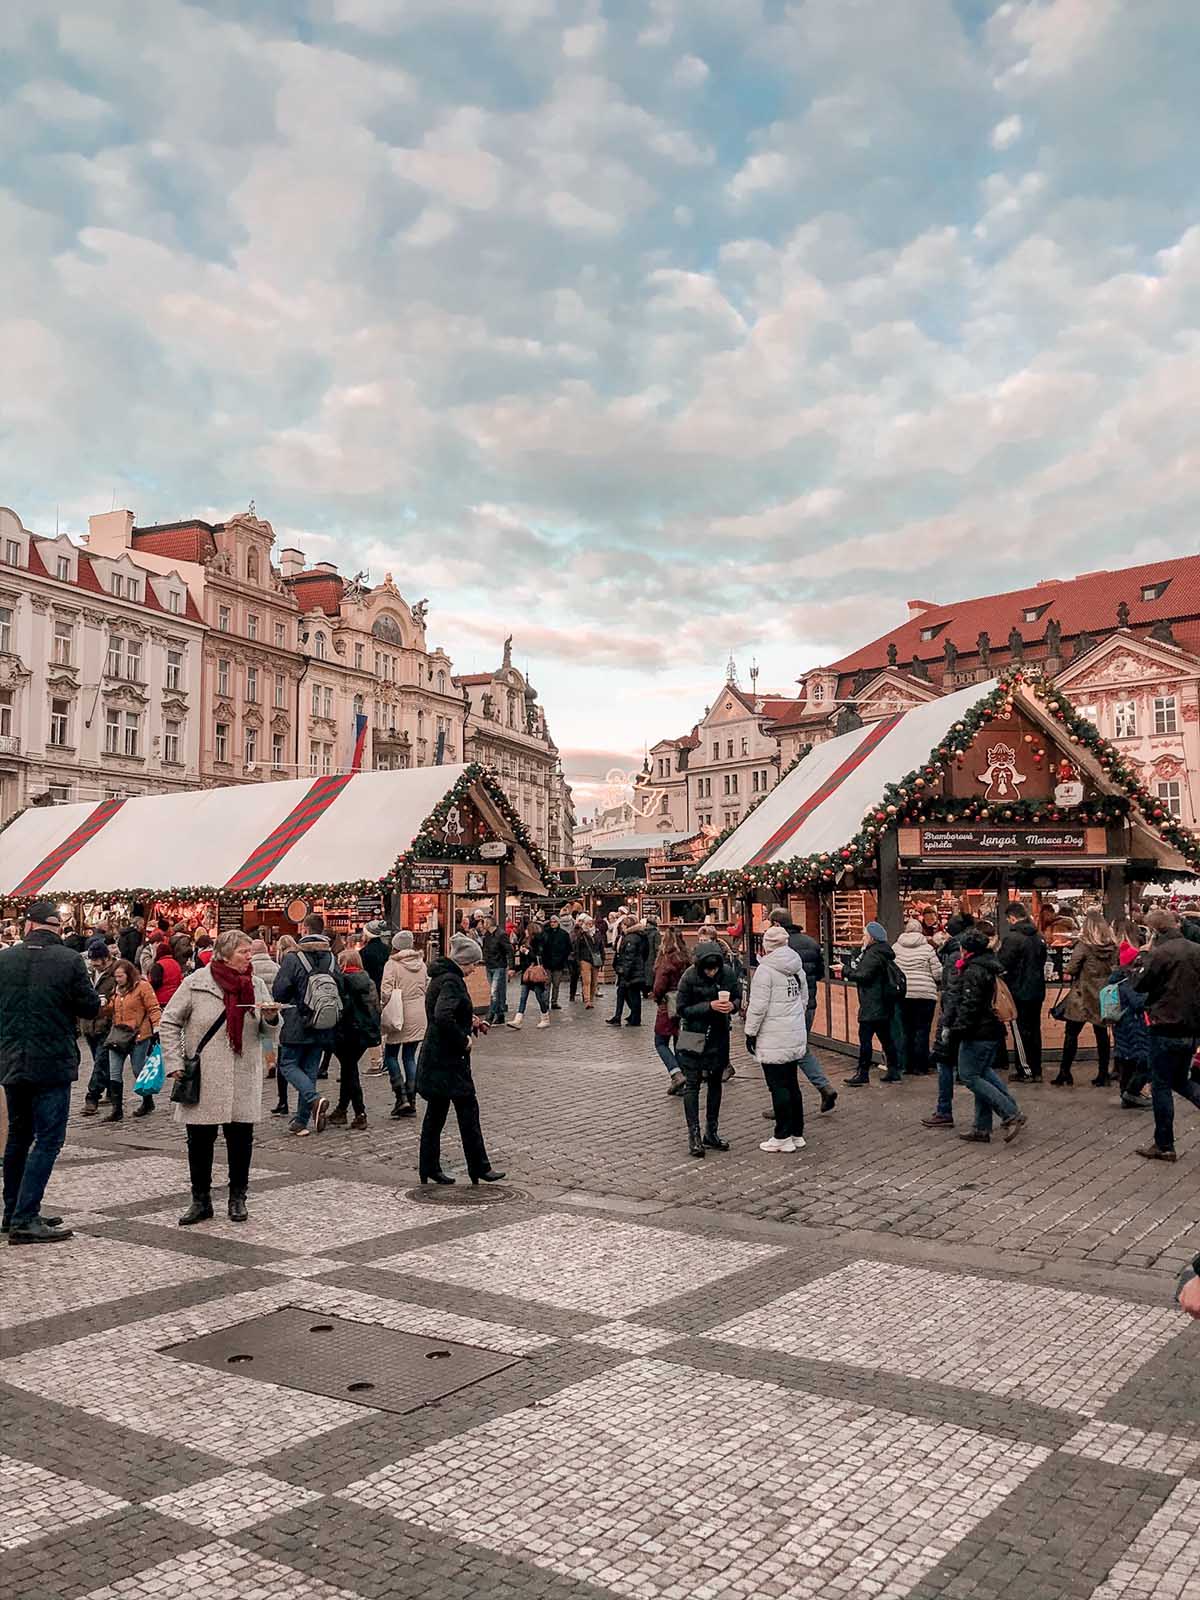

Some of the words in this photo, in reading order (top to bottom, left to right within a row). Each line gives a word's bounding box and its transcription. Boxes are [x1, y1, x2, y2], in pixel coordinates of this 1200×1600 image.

[923, 831, 973, 840] Bramborová
[979, 834, 1017, 848] Langoš
[1025, 834, 1062, 846] Maraca
[1064, 834, 1084, 847] Dog
